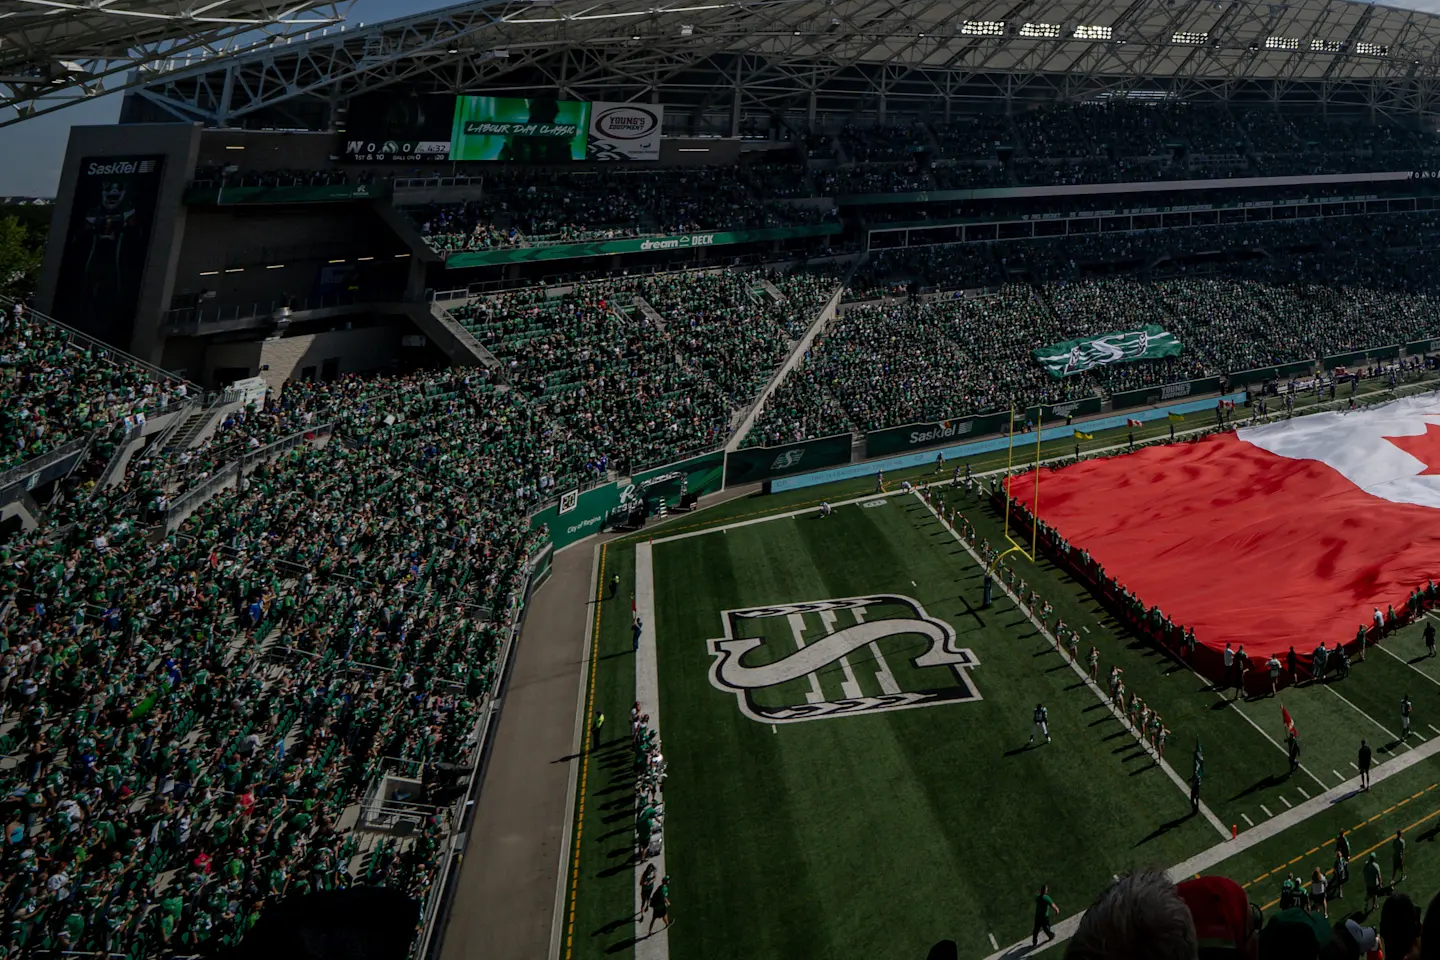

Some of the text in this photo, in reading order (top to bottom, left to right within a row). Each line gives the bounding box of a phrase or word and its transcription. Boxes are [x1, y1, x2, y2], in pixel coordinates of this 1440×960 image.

[609, 117, 646, 125] YOUNG'S
[467, 123, 577, 135] LABOUR DAY CLASSIC
[367, 142, 376, 153] 0
[403, 143, 411, 153] 0
[427, 145, 446, 153] 4:32
[87, 160, 139, 176] SaskTel
[641, 235, 714, 250] dream DECK
[567, 524, 577, 534] City
[584, 515, 602, 528] Regina
